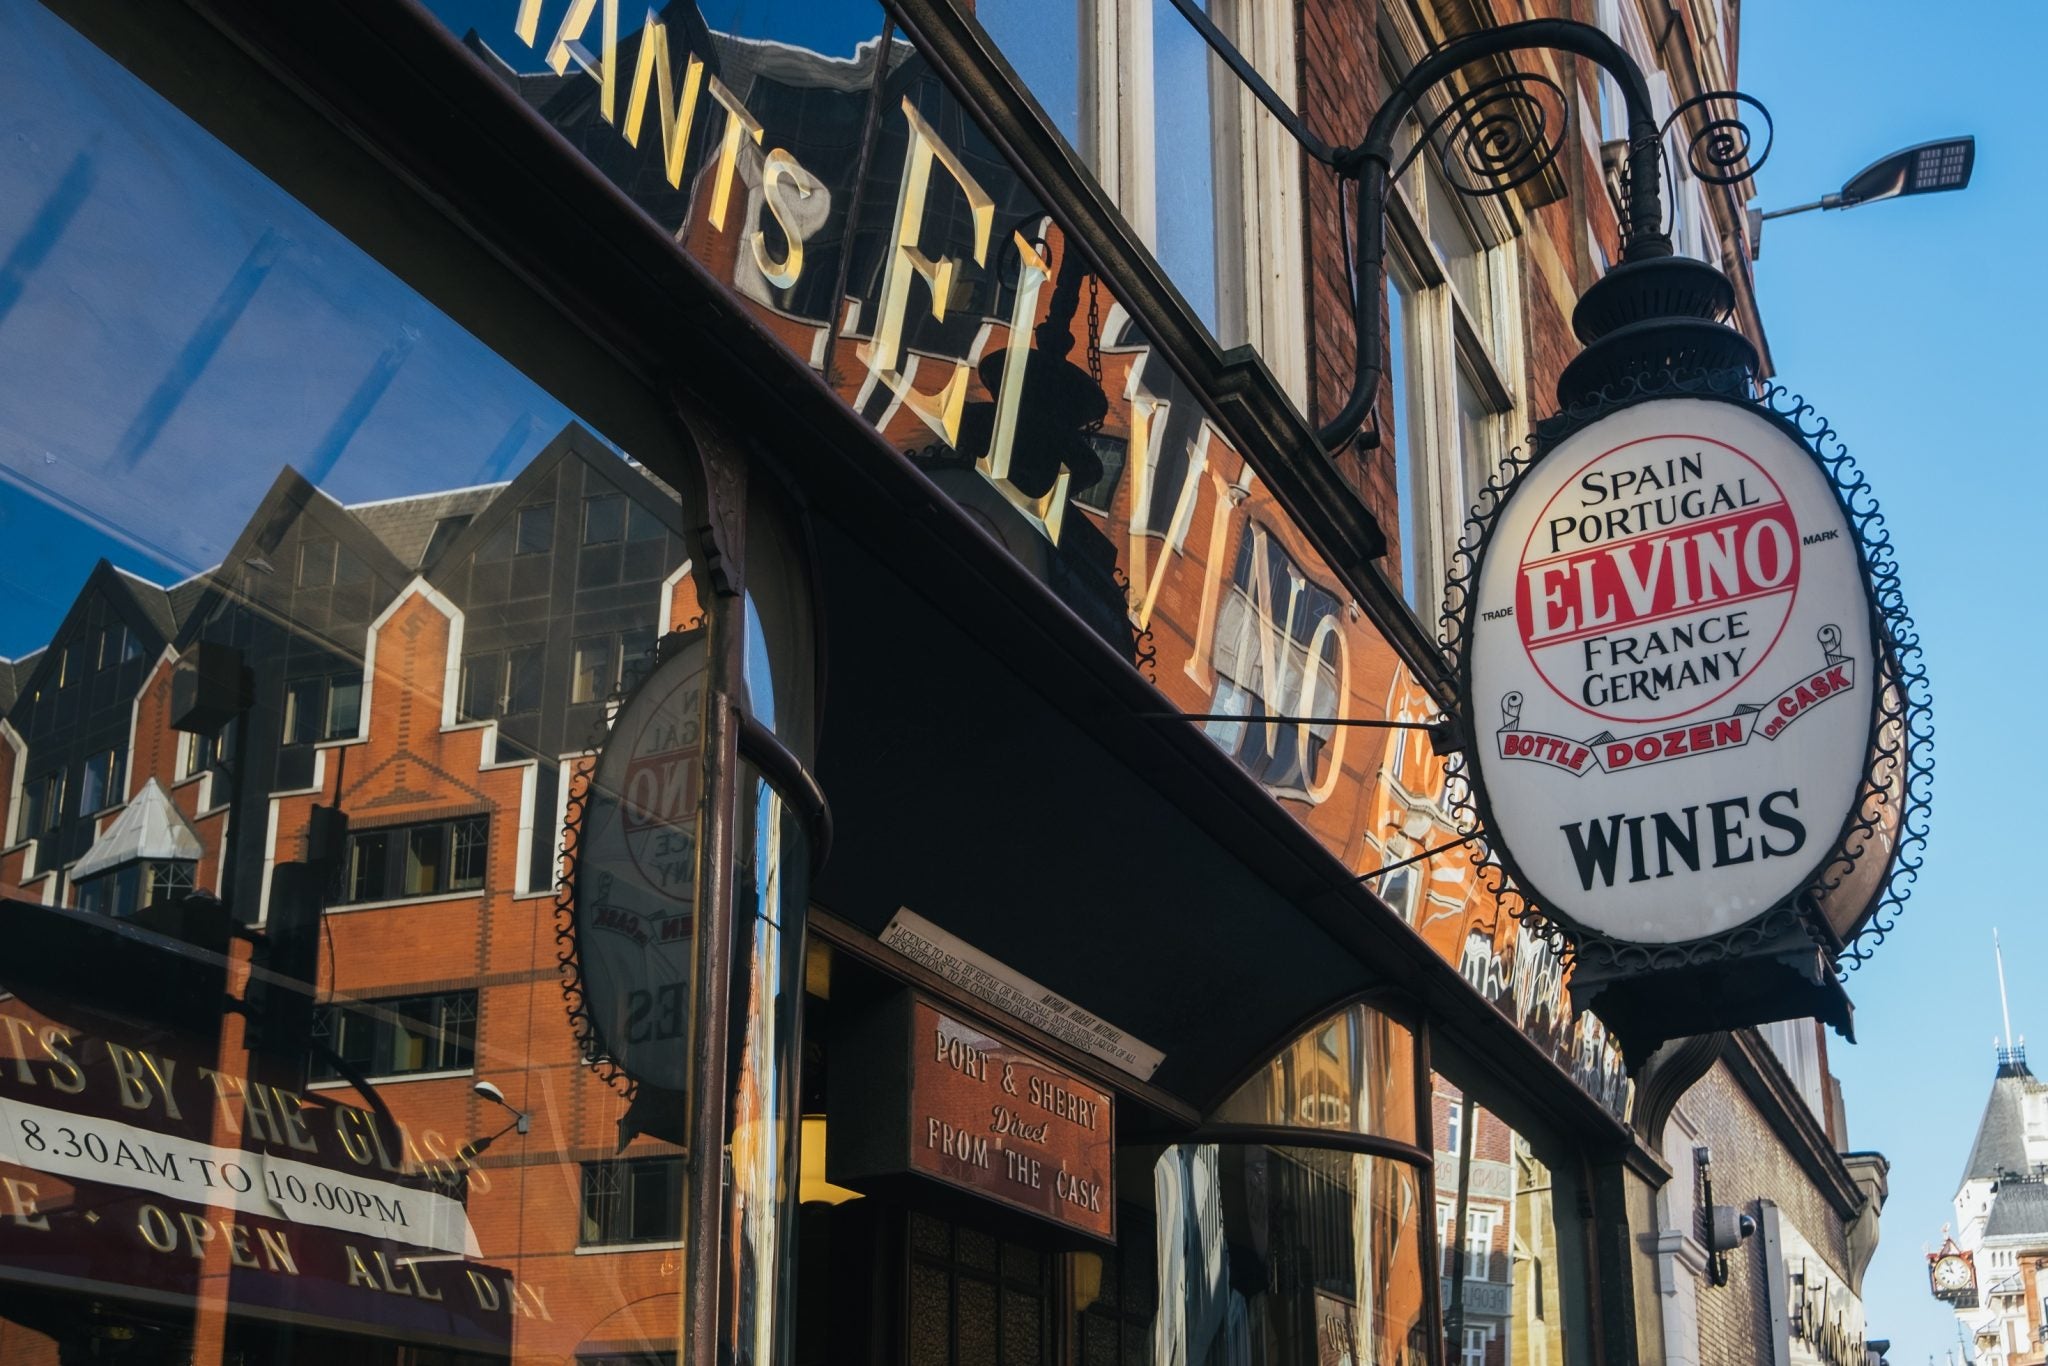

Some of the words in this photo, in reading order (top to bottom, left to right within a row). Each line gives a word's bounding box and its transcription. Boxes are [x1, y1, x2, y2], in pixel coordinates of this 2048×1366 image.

[494, 0, 812, 290] ANTS
[1549, 478, 1760, 554] PORTUGAL
[1579, 452, 1703, 508] SPAIN
[1522, 518, 1794, 642] ELVINO
[1803, 529, 1839, 546] MARK
[1481, 605, 1514, 622] TRADE
[1582, 611, 1750, 672] FRANCE
[1503, 734, 1590, 771] BOTTLE
[1606, 719, 1742, 768] DOZEN
[1764, 714, 1786, 737] OR
[1780, 665, 1852, 717] CASK
[1582, 647, 1747, 707] GERMANY
[1559, 787, 1807, 891] WINES
[887, 935, 945, 971] DESCRIPTIONS
[947, 971, 959, 982] TO
[959, 977, 971, 988] BE
[972, 983, 1011, 1009] CONSUMED
[1012, 1004, 1024, 1015] ON
[1023, 1010, 1034, 1020] OR
[1033, 1015, 1047, 1027] OFF
[1048, 1023, 1062, 1035] THE
[895, 927, 932, 952] LICENCE
[932, 947, 944, 960] TO
[943, 954, 962, 970] SELL
[962, 965, 975, 976] BY
[973, 972, 998, 991] RETAIL
[1000, 985, 1012, 997] OR
[1051, 1014, 1095, 1042] INTOXICATING
[1094, 1037, 1116, 1053] LIQUOR
[1115, 1048, 1124, 1058] OF
[1126, 1053, 1137, 1064] ALL
[0, 1013, 87, 1095] TS
[105, 1040, 184, 1120] BY
[198, 1067, 319, 1154] THE
[333, 1102, 493, 1195] GLASS
[934, 1030, 989, 1083] PORT
[1001, 1063, 1018, 1096] &
[1028, 1074, 1098, 1131] SHERRY
[990, 1104, 1049, 1145] Direct
[19, 1118, 184, 1184] 8.30AM
[188, 1157, 253, 1194] TO
[265, 1168, 412, 1228] 10.00PM
[926, 1116, 989, 1169] FROM
[1004, 1147, 1041, 1189] THE
[1055, 1166, 1101, 1213] CASK
[0, 1177, 52, 1232] E
[137, 1203, 300, 1276] OPEN
[345, 1245, 443, 1300] ALL
[465, 1269, 554, 1322] DAY
